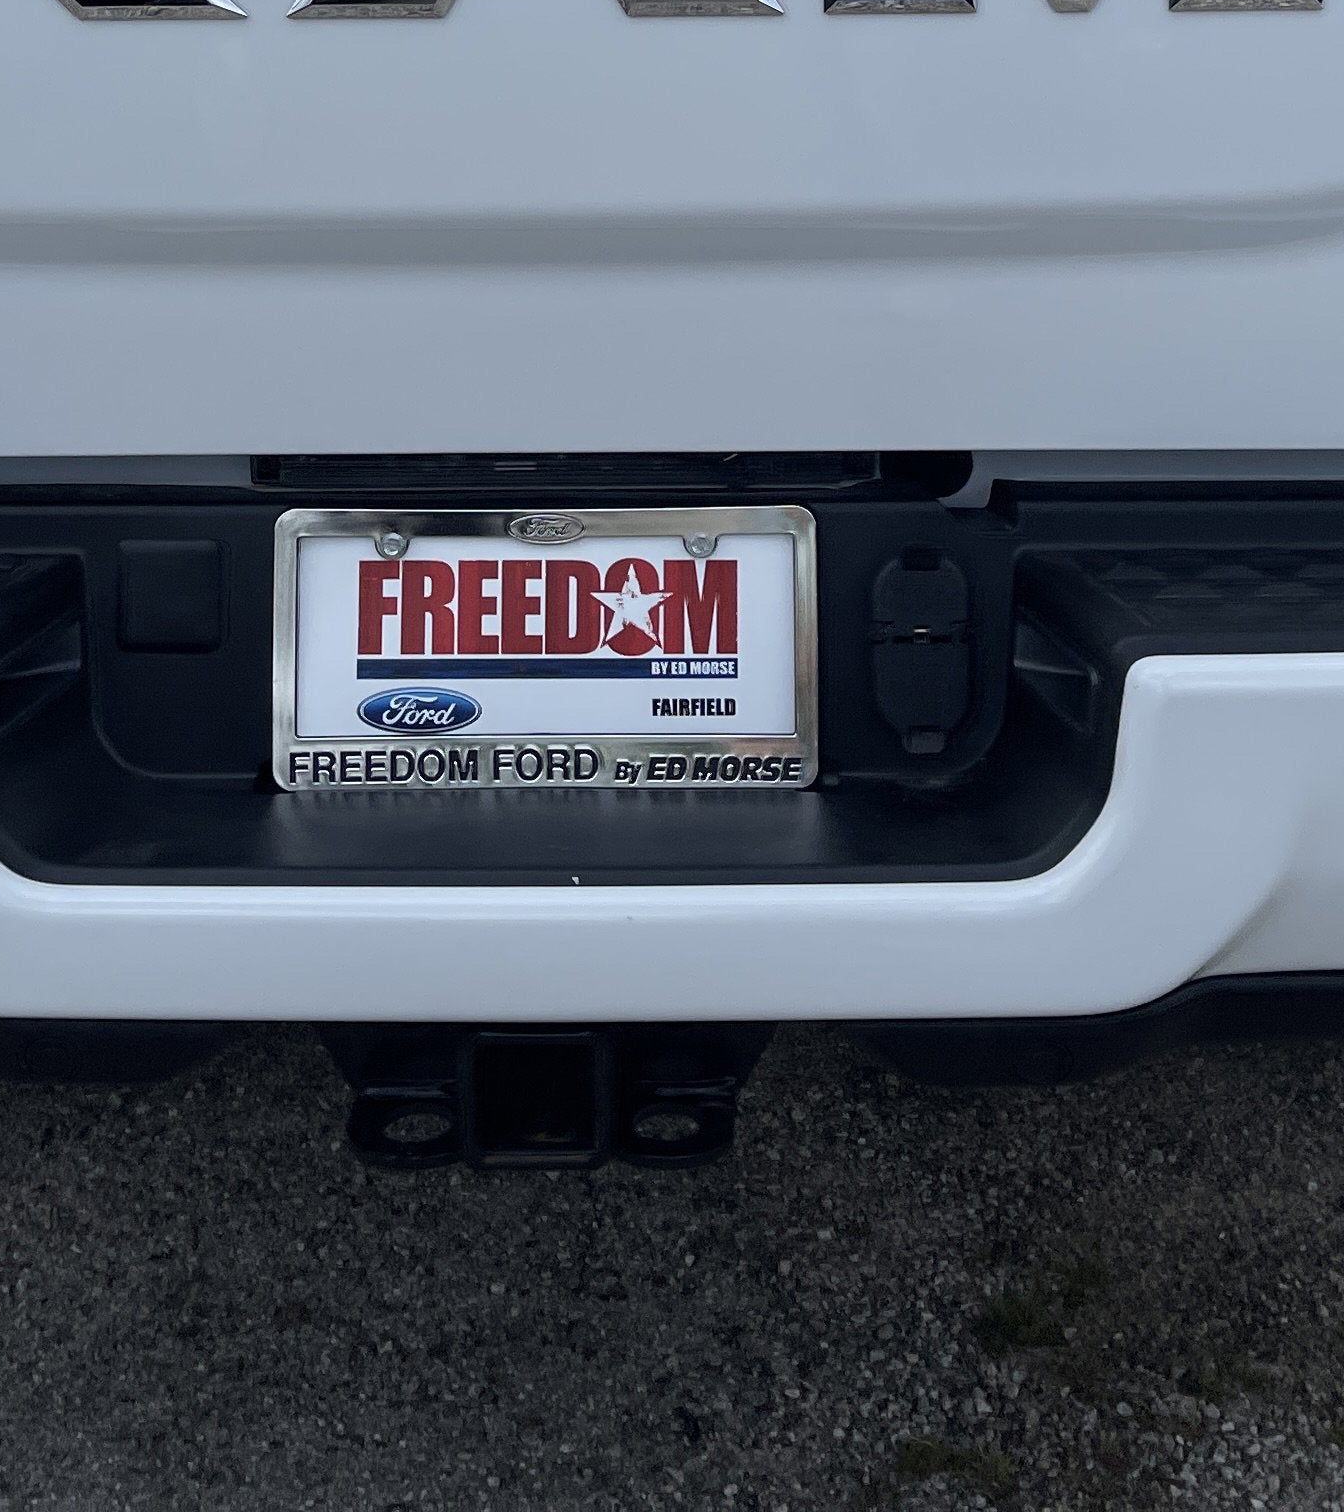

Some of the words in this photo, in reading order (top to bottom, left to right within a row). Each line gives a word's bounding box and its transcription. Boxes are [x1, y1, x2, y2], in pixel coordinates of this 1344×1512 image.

[357, 557, 739, 657] FREEDOM
[651, 661, 669, 676] BY
[670, 661, 687, 676] ED
[690, 661, 736, 676] MORSE
[652, 697, 737, 717] FAIRFIELD
[289, 748, 479, 785] FREEDOM
[492, 746, 599, 783] FORD
[614, 759, 643, 786] By
[646, 754, 688, 783] ED
[691, 754, 803, 783] MORSE
